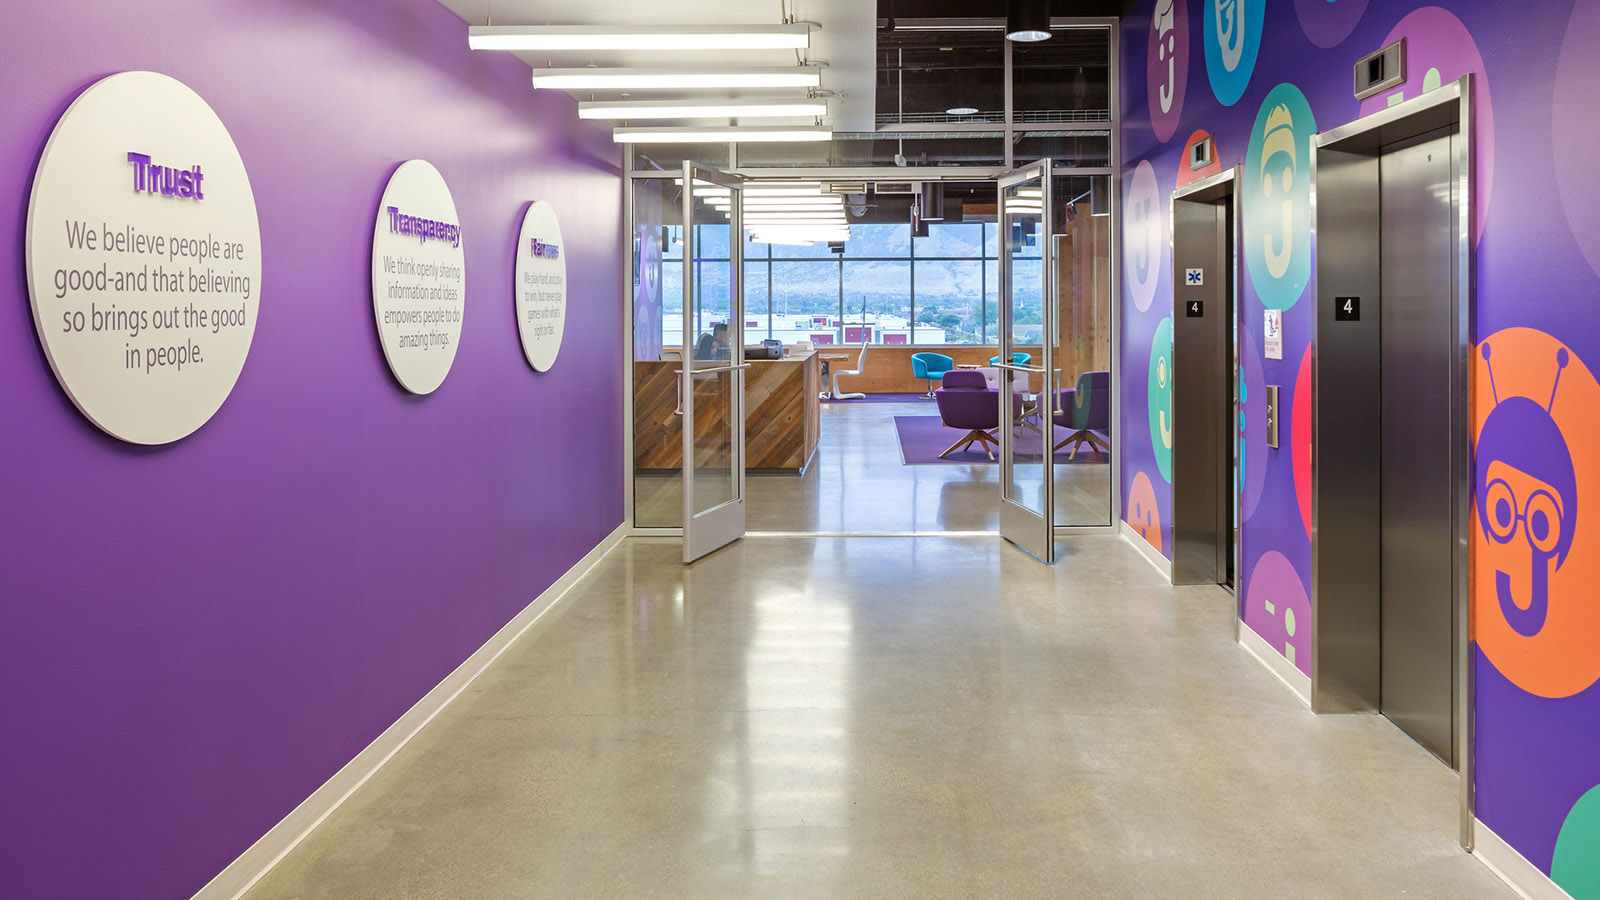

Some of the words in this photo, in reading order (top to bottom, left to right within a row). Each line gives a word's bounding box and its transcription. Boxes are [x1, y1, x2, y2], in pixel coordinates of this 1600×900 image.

[127, 151, 204, 200] Trust
[65, 220, 97, 250] We
[103, 222, 165, 255] believe
[169, 233, 220, 264] people
[223, 242, 244, 260] are
[387, 206, 461, 248] Transparency
[54, 262, 147, 299] good-and
[152, 265, 184, 293] that
[188, 267, 250, 299] believing
[383, 255, 396, 274] We
[397, 256, 416, 275] think
[416, 259, 438, 280] openly
[439, 260, 460, 283] sharing
[387, 281, 428, 300] information
[429, 284, 442, 300] and
[442, 285, 458, 301] ideas
[1343, 298, 1353, 314] 4
[63, 310, 85, 333] so
[91, 302, 148, 338] brings
[152, 306, 180, 329] out
[183, 302, 207, 328] the
[211, 302, 246, 334] good
[384, 309, 422, 328] empowers
[423, 307, 444, 327] people
[445, 307, 452, 323] to
[452, 307, 460, 322] do
[1191, 302, 1199, 313] 4
[125, 342, 141, 369] in
[146, 337, 204, 374] people.
[399, 332, 428, 351] amazing
[429, 330, 450, 349] things.
